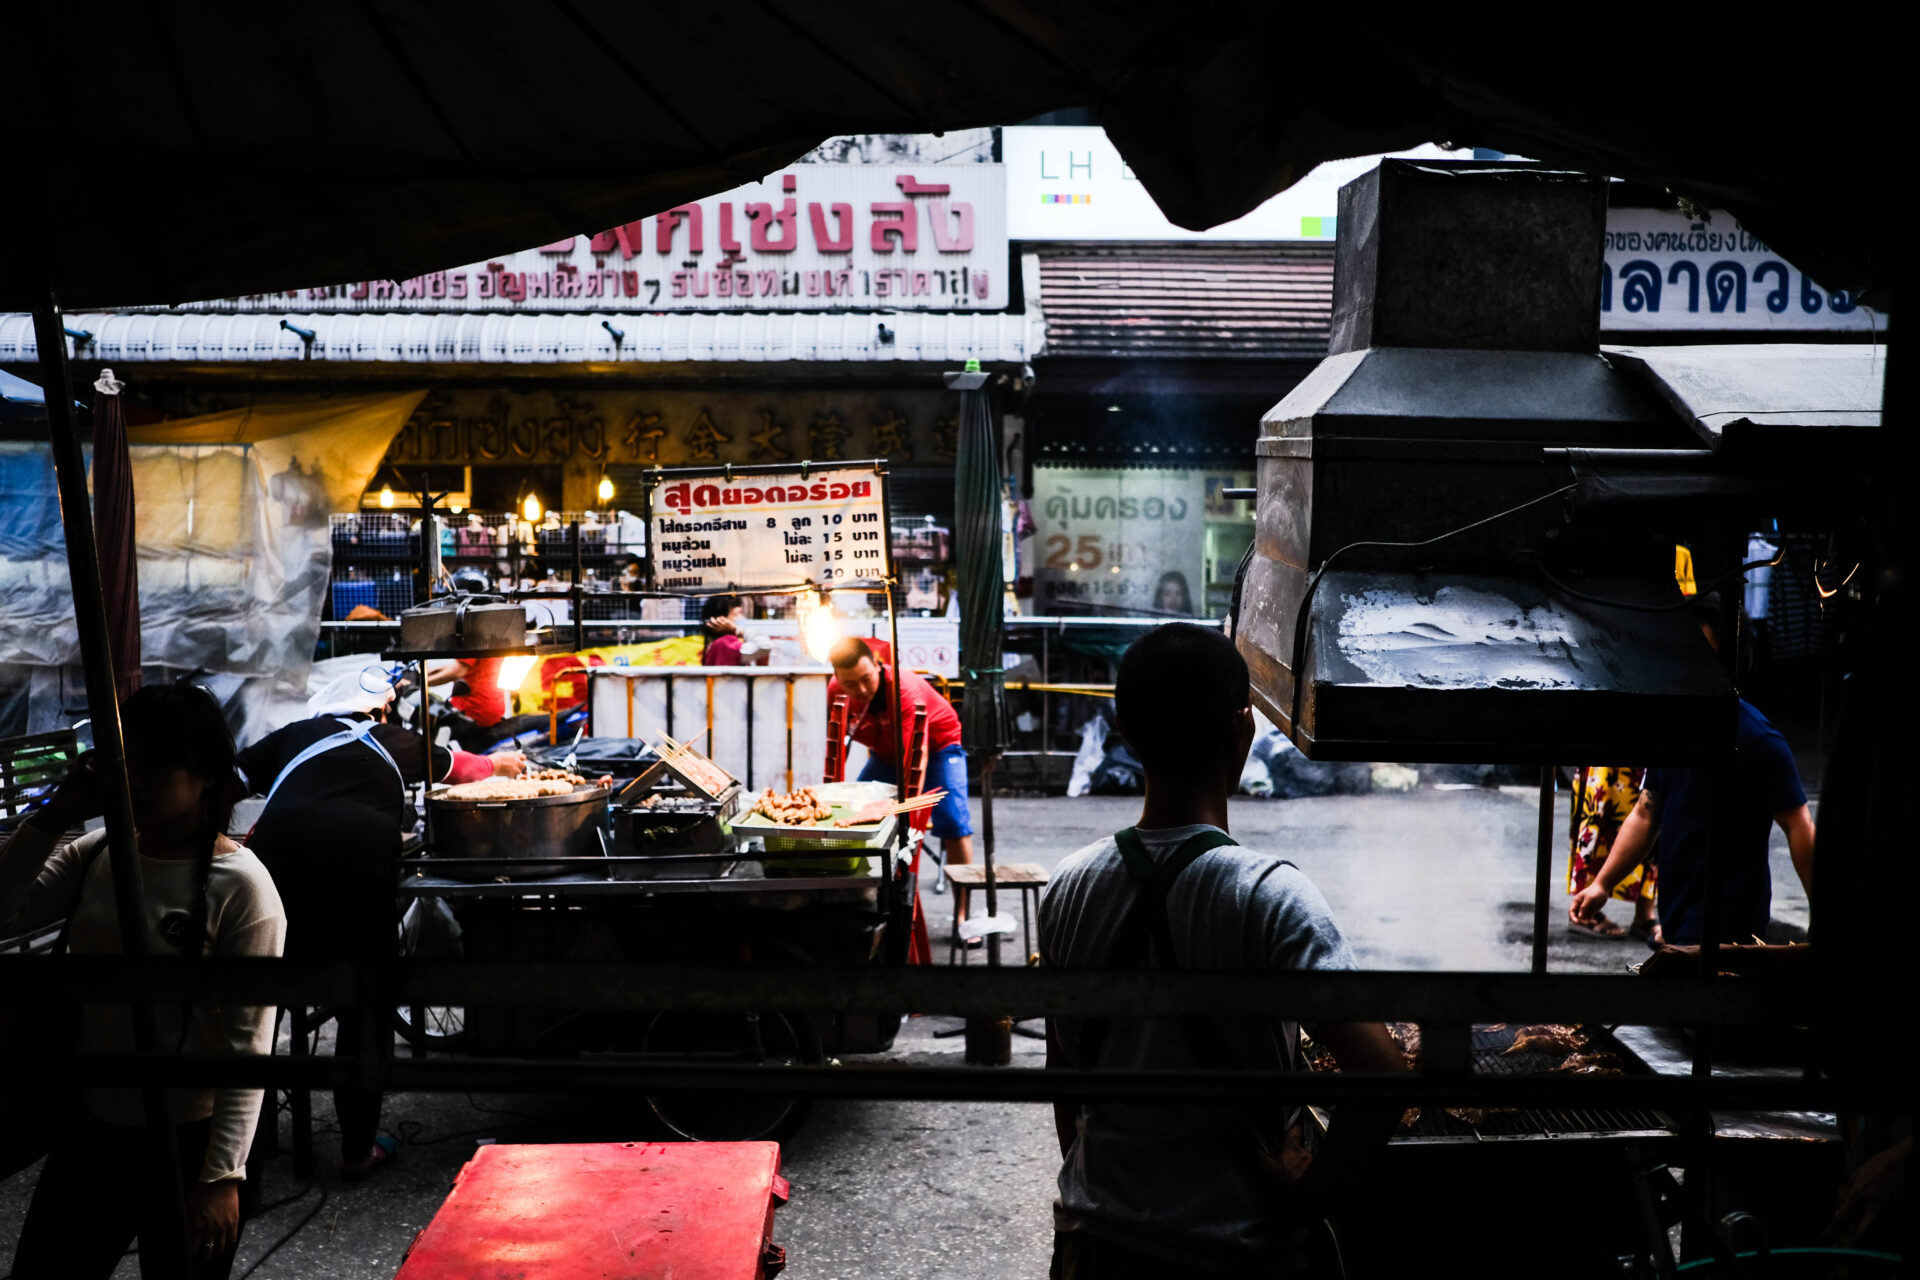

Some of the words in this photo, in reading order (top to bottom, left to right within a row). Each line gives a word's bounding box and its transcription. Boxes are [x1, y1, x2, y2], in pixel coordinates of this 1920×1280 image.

[1041, 151, 1092, 180] LH
[664, 477, 871, 515] สุดยอดอร่อย
[1046, 486, 1188, 530] คุ้มครอง
[766, 518, 776, 528] 8
[791, 516, 811, 530] ลูก
[822, 514, 842, 525] 10
[852, 512, 878, 523] บาท
[662, 536, 711, 555] หมูล้วน
[823, 532, 843, 544] 15
[852, 530, 878, 542] บาท
[823, 550, 843, 562] 15
[853, 548, 879, 559] บาท
[1046, 534, 1102, 570] 25
[824, 568, 844, 580] 20
[855, 567, 880, 578] บาท
